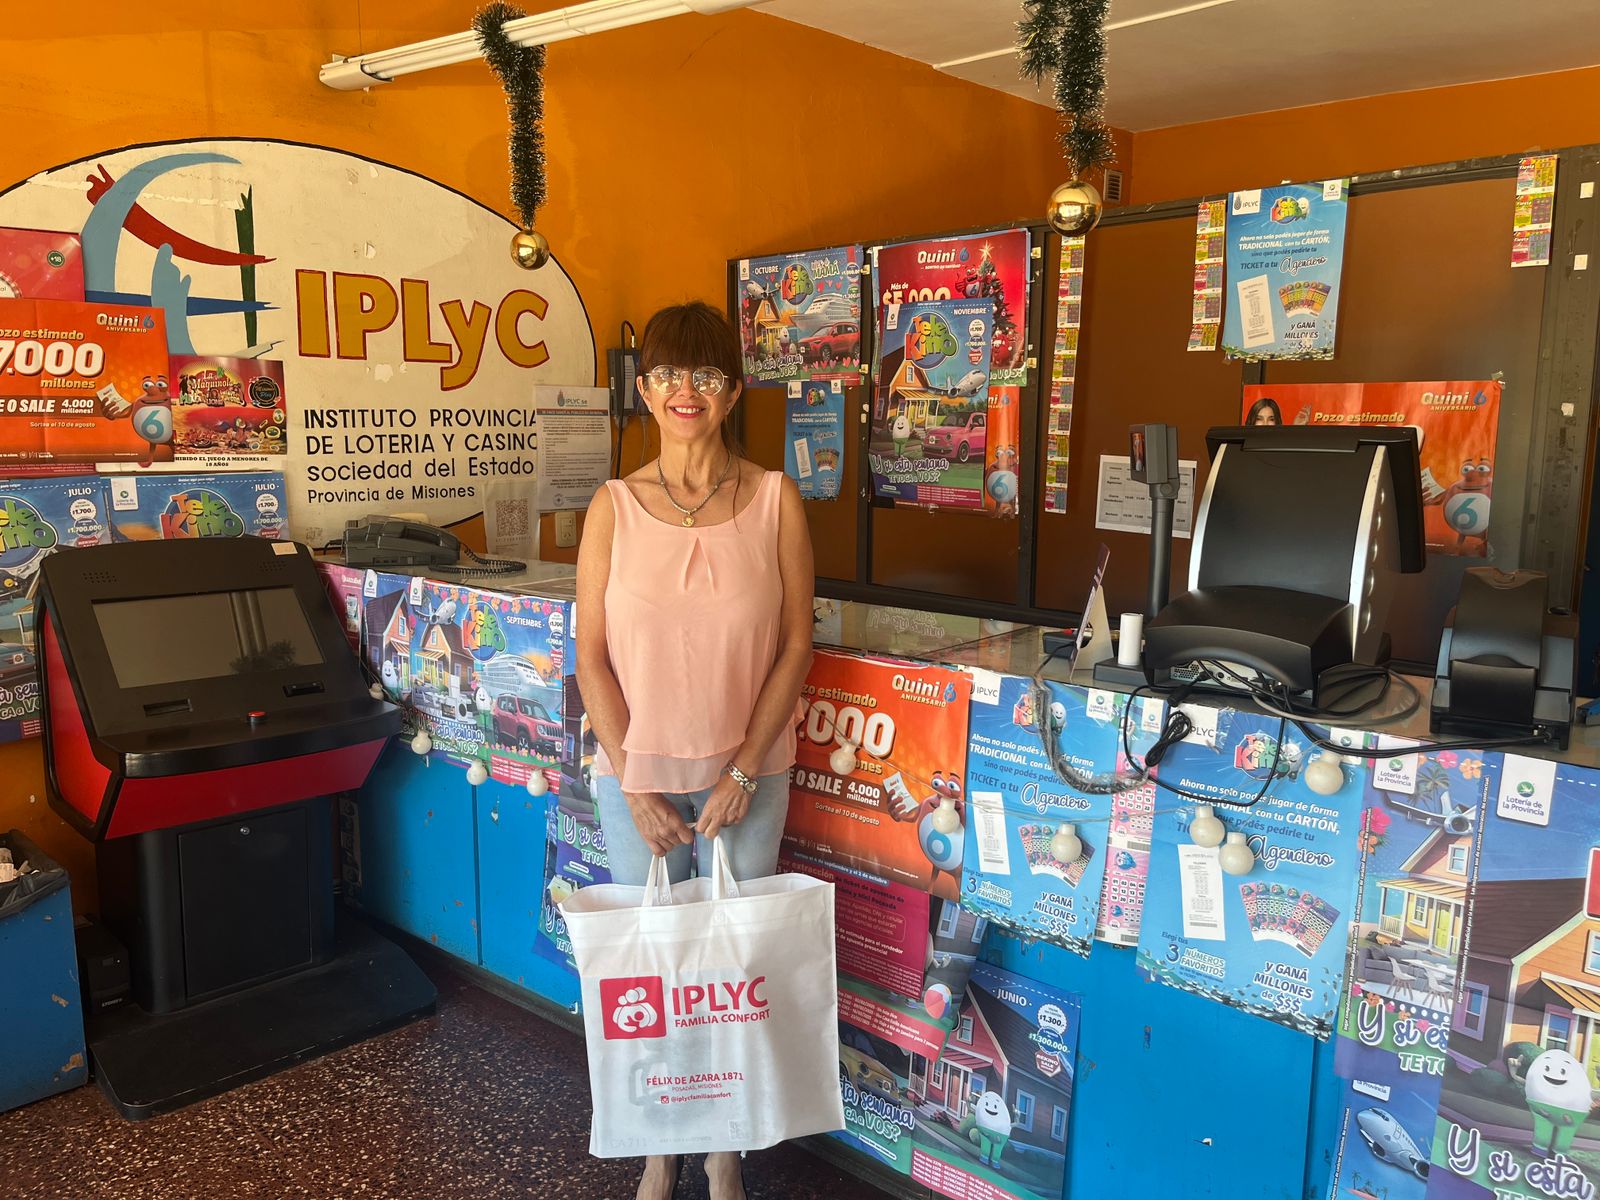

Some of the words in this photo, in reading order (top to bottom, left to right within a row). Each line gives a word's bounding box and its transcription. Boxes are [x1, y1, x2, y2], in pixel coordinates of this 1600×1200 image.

[1242, 200, 1259, 208] IPLYC
[1238, 241, 1284, 251] TRADICIONAL
[917, 248, 957, 264] Quini
[1240, 261, 1264, 270] TICKET
[754, 266, 779, 276] OCTUBRE
[890, 282, 902, 290] Más
[96, 313, 140, 328] Quini
[143, 314, 155, 330] 6
[954, 308, 987, 316] NOVIEMBRE
[0, 329, 20, 338] ozo
[22, 328, 84, 340] estimado
[106, 326, 148, 334] ANIVERSARIO
[295, 268, 551, 392] IPLyC
[40, 377, 96, 390] millones
[20, 399, 56, 414] SALE
[61, 399, 94, 408] 4.000
[1420, 391, 1470, 406] Quini
[1474, 390, 1487, 406] 6
[140, 410, 165, 440] 6
[304, 409, 416, 428] INSTITUTO
[430, 408, 536, 428] PROVINCIA
[1314, 412, 1344, 422] Pozo
[1346, 412, 1406, 422] estimado
[306, 435, 334, 455] DE
[344, 434, 435, 454] LOTERIA
[442, 433, 456, 452] Y
[424, 458, 456, 478] del
[468, 456, 534, 476] Estado
[68, 488, 92, 498] JULIO
[254, 484, 276, 492] JULIO
[308, 488, 380, 503] Provincia
[386, 486, 404, 500] de
[412, 484, 475, 500] Misiones
[1452, 496, 1478, 530] 6
[506, 615, 543, 628] SEPTIEMBRE
[818, 686, 878, 708] estimado
[892, 674, 941, 698] Quini
[944, 682, 957, 703] 6
[976, 686, 998, 698] IPLYC
[900, 694, 947, 708] ANIVERSARIO
[1191, 726, 1214, 738] PLYC
[972, 733, 991, 744] Ahora
[992, 738, 1001, 746] no
[1002, 740, 1016, 750] solo
[1017, 744, 1040, 756] podés
[969, 743, 1028, 766] TRADICIONAL
[1030, 760, 1044, 770] con
[1070, 756, 1094, 768] forma
[984, 760, 998, 770] sino
[1000, 764, 1014, 774] que
[1014, 766, 1038, 779] podés
[1380, 770, 1400, 780] Lotería
[807, 772, 843, 796] SALE
[848, 781, 880, 799] 4.000
[1384, 776, 1412, 787] Provincia
[846, 792, 880, 807] millones!
[970, 771, 1000, 787] TICKET
[1008, 782, 1019, 793] tu
[1022, 782, 1090, 814] Agenciero
[1180, 778, 1206, 791] Ahora
[1206, 784, 1218, 793] no
[1218, 786, 1238, 798] solo
[1268, 796, 1294, 810] jugar
[1296, 801, 1307, 811] de
[1308, 804, 1339, 818] forma
[1506, 795, 1532, 807] Lotería
[1534, 800, 1543, 809] de
[1510, 803, 1544, 816] Provincia
[564, 814, 577, 844] Y
[858, 814, 880, 826] agosto
[1236, 816, 1265, 831] podés
[1266, 823, 1302, 839] pedirle
[1304, 832, 1315, 842] tu
[1256, 808, 1272, 820] con
[1274, 812, 1284, 822] tu
[1286, 811, 1340, 836] CARTÓN,
[1246, 834, 1335, 871] Agenciero
[792, 862, 834, 880] extracción
[966, 877, 977, 894] 3
[981, 880, 1012, 898] NÚMEROS
[978, 887, 1012, 906] FAVORITOS
[1048, 893, 1073, 909] GANÁ
[1034, 900, 1076, 924] MILLONES
[1039, 915, 1048, 924] de
[1049, 918, 1068, 935] $$$
[1178, 936, 1188, 945] tus
[1166, 943, 1180, 963] 3
[1184, 948, 1225, 968] NÚMEROS
[1180, 956, 1225, 978] FAVORITOS
[1264, 962, 1274, 973] y
[1276, 962, 1308, 982] GANÁ
[1254, 972, 1313, 1000] MILLONES
[672, 976, 769, 1016] IPLYC
[996, 988, 1027, 1007] JUNIO
[1262, 990, 1273, 1000] de
[1274, 992, 1302, 1014] $$$
[674, 1015, 719, 1028] FAMILIA
[720, 1008, 770, 1024] CONFORT
[1358, 998, 1385, 1046] Y
[1393, 1018, 1420, 1046] si
[1398, 1052, 1424, 1073] TE
[646, 1076, 673, 1086] FÉLIX
[674, 1076, 687, 1085] DE
[688, 1073, 721, 1084] AZARA
[722, 1072, 744, 1081] 1871
[670, 1092, 732, 1102] @iplycfamiliaconfort
[840, 1076, 859, 1107] ta
[860, 1091, 916, 1131] semana
[864, 1110, 902, 1144] VOS?
[1448, 1124, 1480, 1176] Y
[1488, 1150, 1521, 1182] si
[1525, 1153, 1595, 1200] esta
